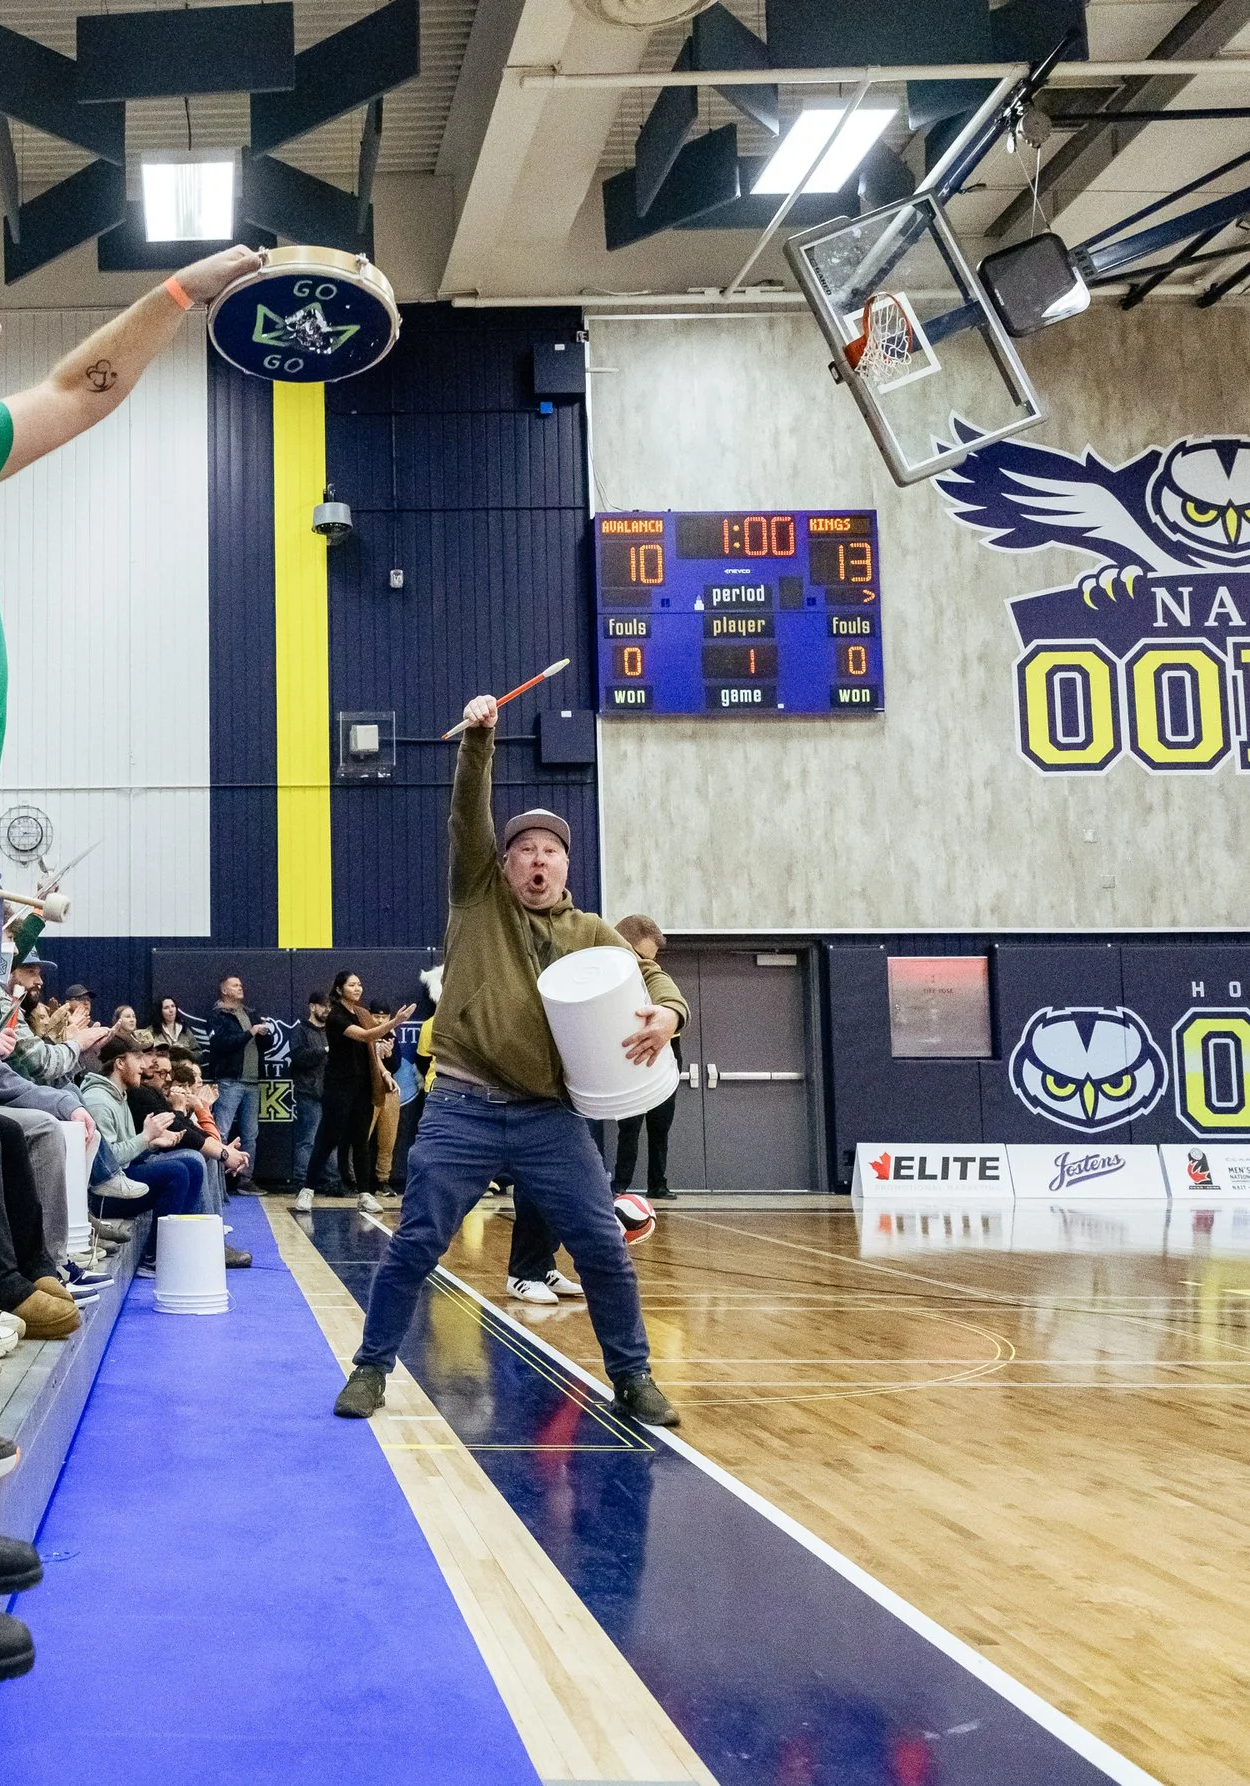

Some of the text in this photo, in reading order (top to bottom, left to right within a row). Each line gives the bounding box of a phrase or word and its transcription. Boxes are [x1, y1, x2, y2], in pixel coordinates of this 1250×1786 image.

[293, 280, 338, 301] GO
[263, 354, 304, 373] GO
[602, 519, 663, 534] AVALANCH
[810, 518, 851, 532] KINGS
[723, 516, 795, 556] 1:00
[629, 544, 663, 584] 10
[838, 542, 872, 582] 13
[712, 585, 766, 606] period
[609, 617, 647, 636] fouls
[713, 617, 766, 637] player
[832, 616, 871, 635] fouls
[623, 647, 642, 676] 0
[847, 646, 867, 675] 0
[614, 690, 645, 704] won
[721, 688, 762, 706] game
[839, 689, 870, 703] won
[1013, 637, 1250, 777] OO
[893, 1156, 1001, 1181] ELITE
[1049, 1151, 1126, 1191] Jostens
